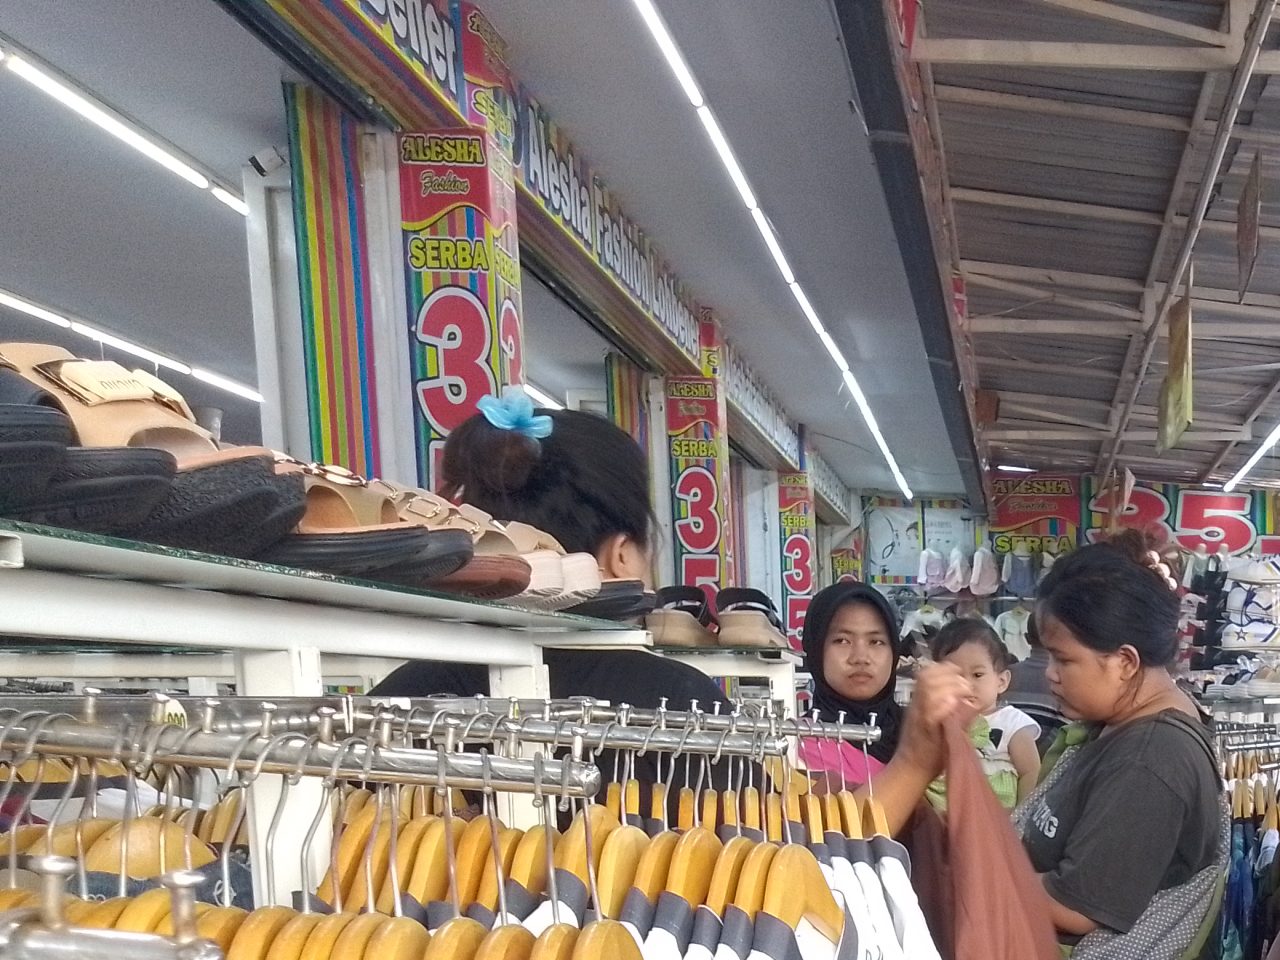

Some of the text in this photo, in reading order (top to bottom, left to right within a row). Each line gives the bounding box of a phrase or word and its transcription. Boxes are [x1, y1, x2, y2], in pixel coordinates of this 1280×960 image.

[402, 135, 485, 164] ALESHA
[420, 170, 470, 197] Fashion
[528, 106, 593, 243] Alesha
[593, 183, 651, 306] Fashion
[409, 237, 490, 272] SERBA
[672, 440, 717, 457] SERBA
